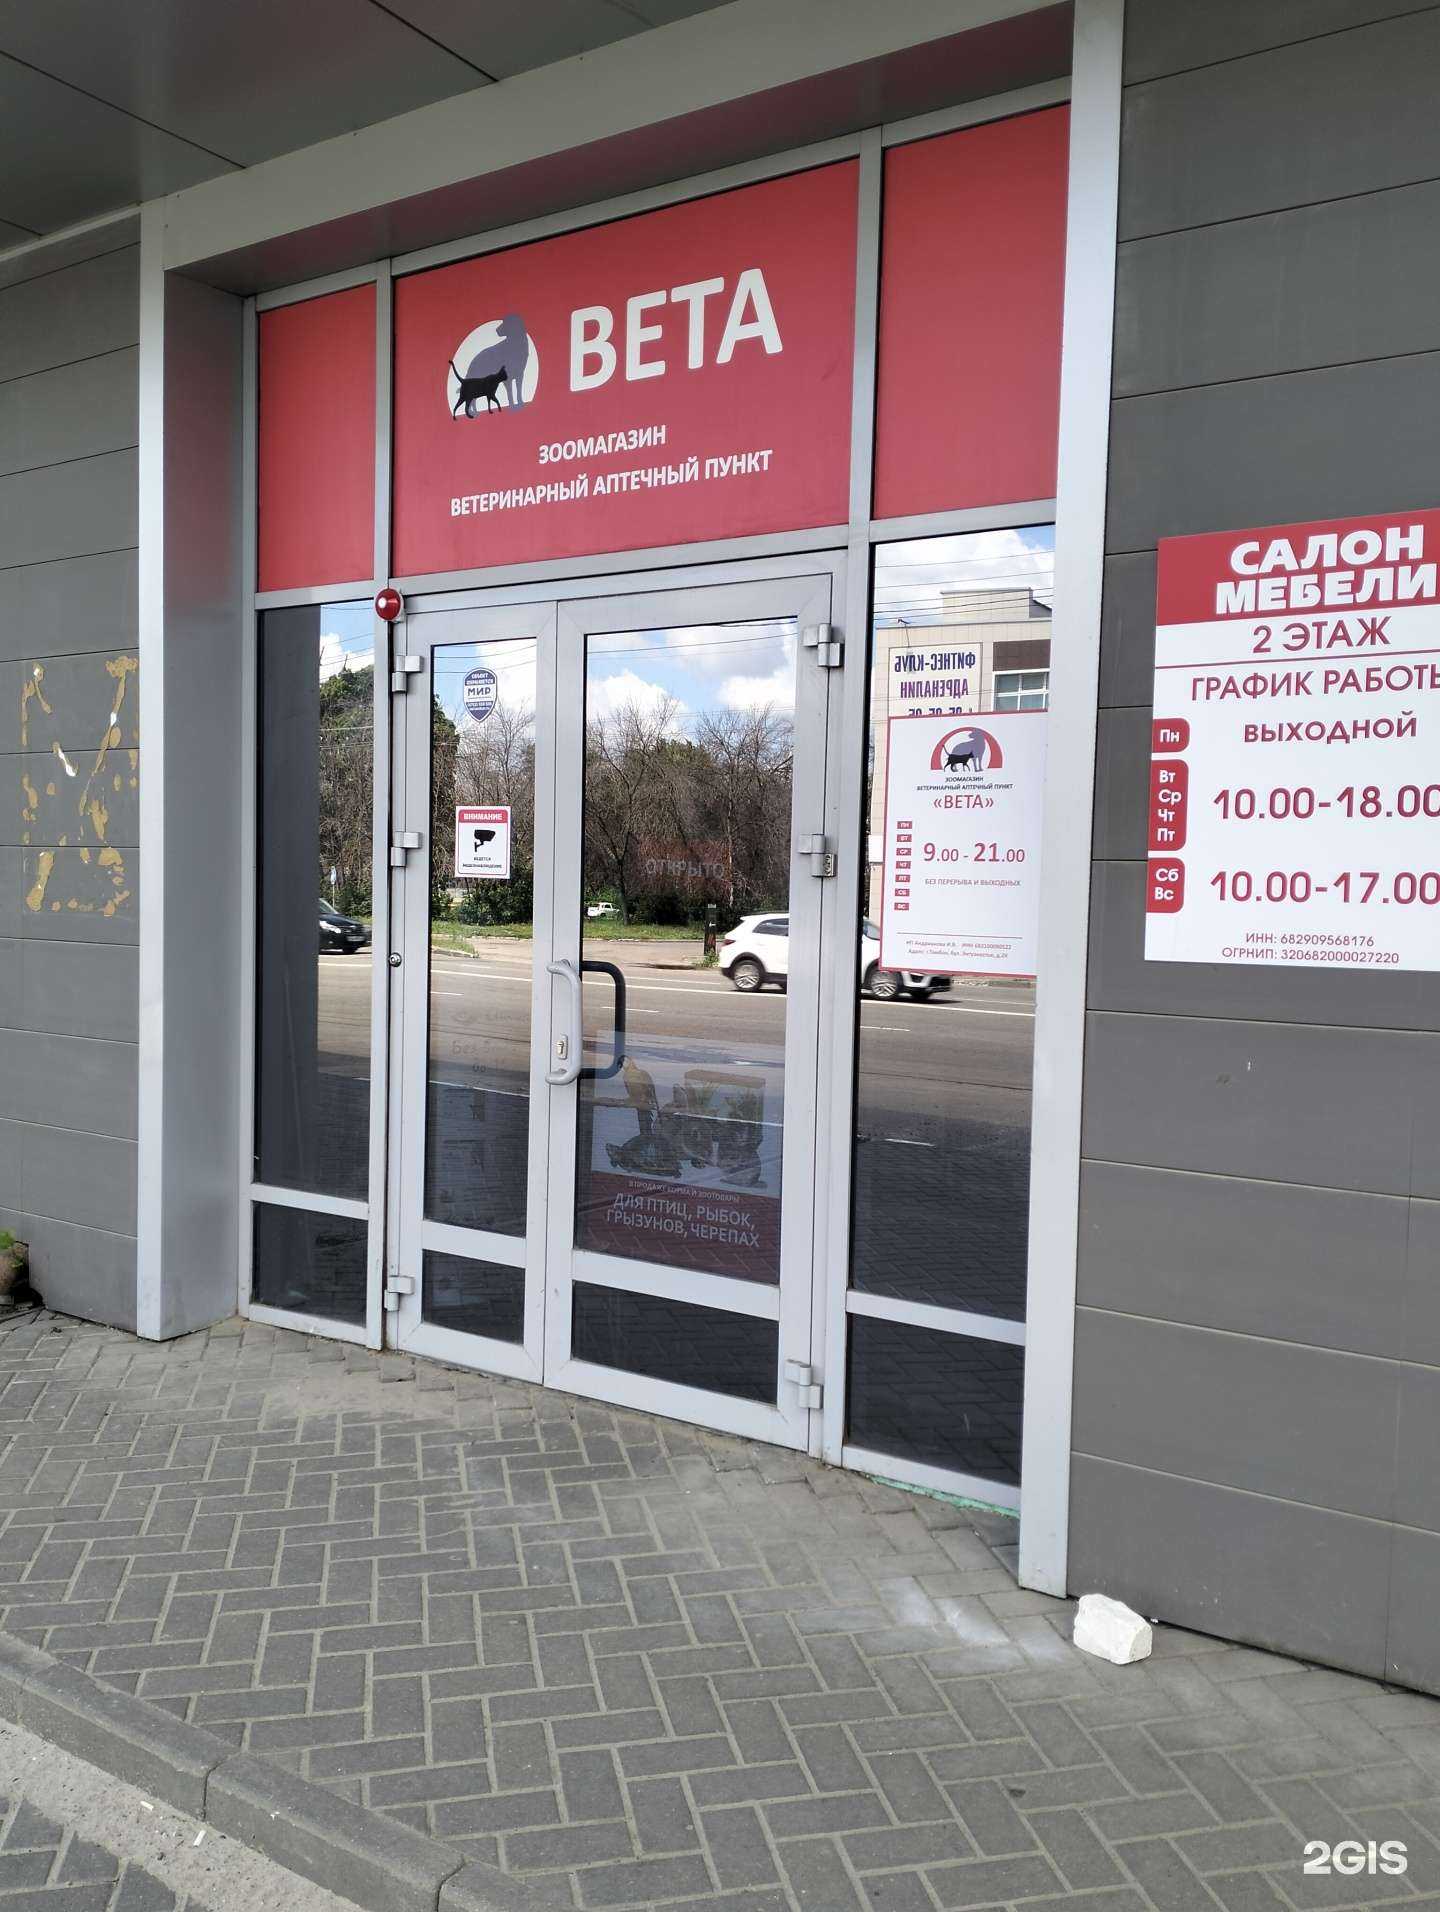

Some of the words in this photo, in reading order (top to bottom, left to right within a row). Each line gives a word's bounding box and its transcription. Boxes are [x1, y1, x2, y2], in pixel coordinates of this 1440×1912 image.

[570, 268, 783, 392] ВЕТА
[538, 425, 666, 464] ЗООМАГАЗИН
[451, 474, 589, 517] ВЕТЕРИНАРНЫЙ
[593, 457, 699, 495] АПТЕЧНЫЙ
[705, 450, 773, 479] ПУНКТ
[1230, 524, 1424, 575] САЛОН
[1216, 563, 1437, 614] МЕБЕЛИ
[1253, 625, 1272, 653] 2
[1282, 616, 1392, 651] ЭТАЖ
[468, 687, 491, 696] МИР
[1191, 670, 1314, 701] ГРАФИК
[1160, 729, 1180, 743] Пн
[1244, 710, 1417, 744] ВЫХОДНОЙ
[1159, 770, 1176, 783] Вт
[933, 794, 994, 809] «ВЕТА»
[1158, 790, 1182, 805] Ср
[1213, 784, 1440, 820] 10.00-18.00
[1158, 809, 1175, 822] Чт
[1157, 828, 1175, 842] Пт
[923, 842, 959, 862] 9.00
[974, 842, 1025, 863] 21.00
[1155, 868, 1179, 882] Сб
[1210, 871, 1440, 905] 10.00-17.00
[1155, 888, 1175, 901] Вс
[1222, 947, 1278, 960] ОГРНИП:
[1245, 933, 1278, 944] ИНН:
[1280, 934, 1375, 948] 682909568176
[614, 1192, 644, 1211] ДЛЯ
[647, 1197, 693, 1221] ПТИЦ,
[696, 1204, 756, 1231] РЫБОК,
[607, 1209, 688, 1240] ГРЫЗУНОВ,
[690, 1222, 761, 1248] ЧЕРЕПАХ
